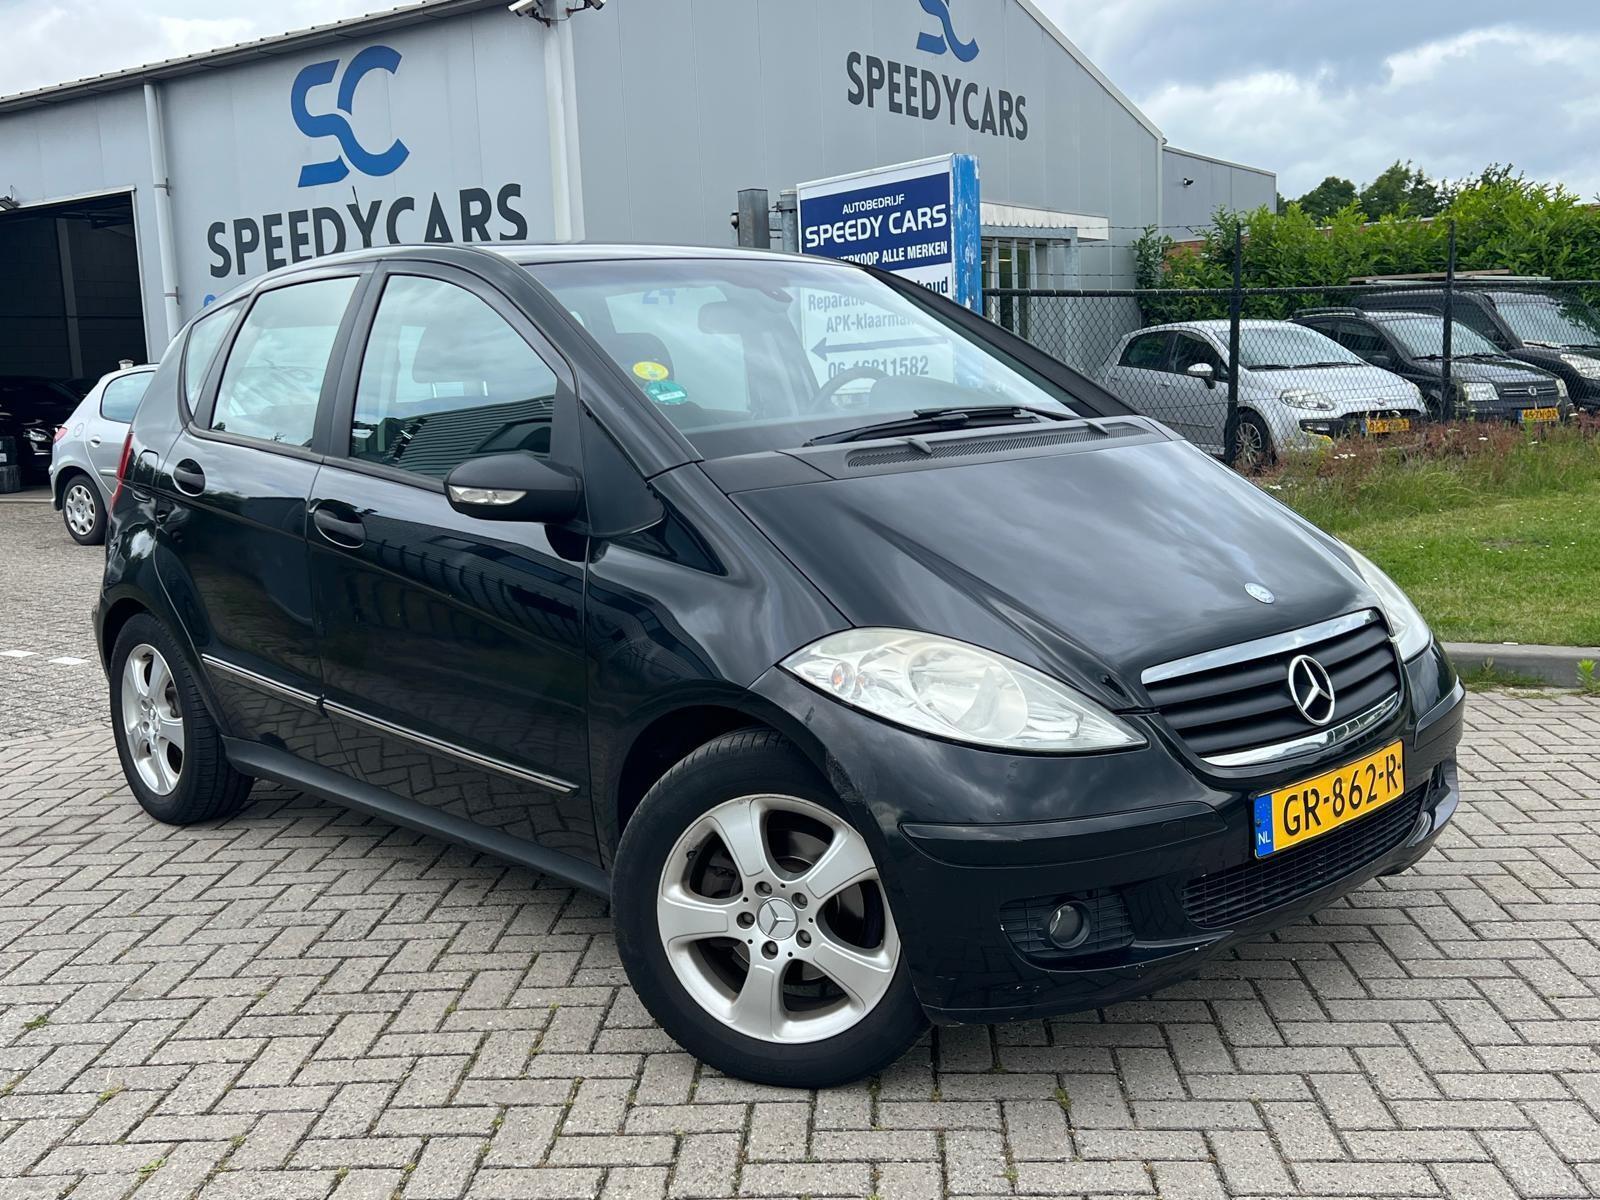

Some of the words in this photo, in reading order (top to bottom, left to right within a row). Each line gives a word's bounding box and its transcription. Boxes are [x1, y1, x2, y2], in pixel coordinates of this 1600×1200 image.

[290, 45, 410, 188] SC
[846, 51, 1028, 141] SPEEDYCARS
[207, 183, 528, 278] SPEEDYCARS
[805, 214, 884, 248] SPEEDY
[888, 203, 947, 235] CARS
[842, 193, 905, 215] AUTOBEDRIJF
[882, 247, 905, 264] ALLE
[907, 240, 948, 260] MERKEN
[1283, 753, 1398, 836] GR-862-R
[1258, 831, 1271, 845] NL
